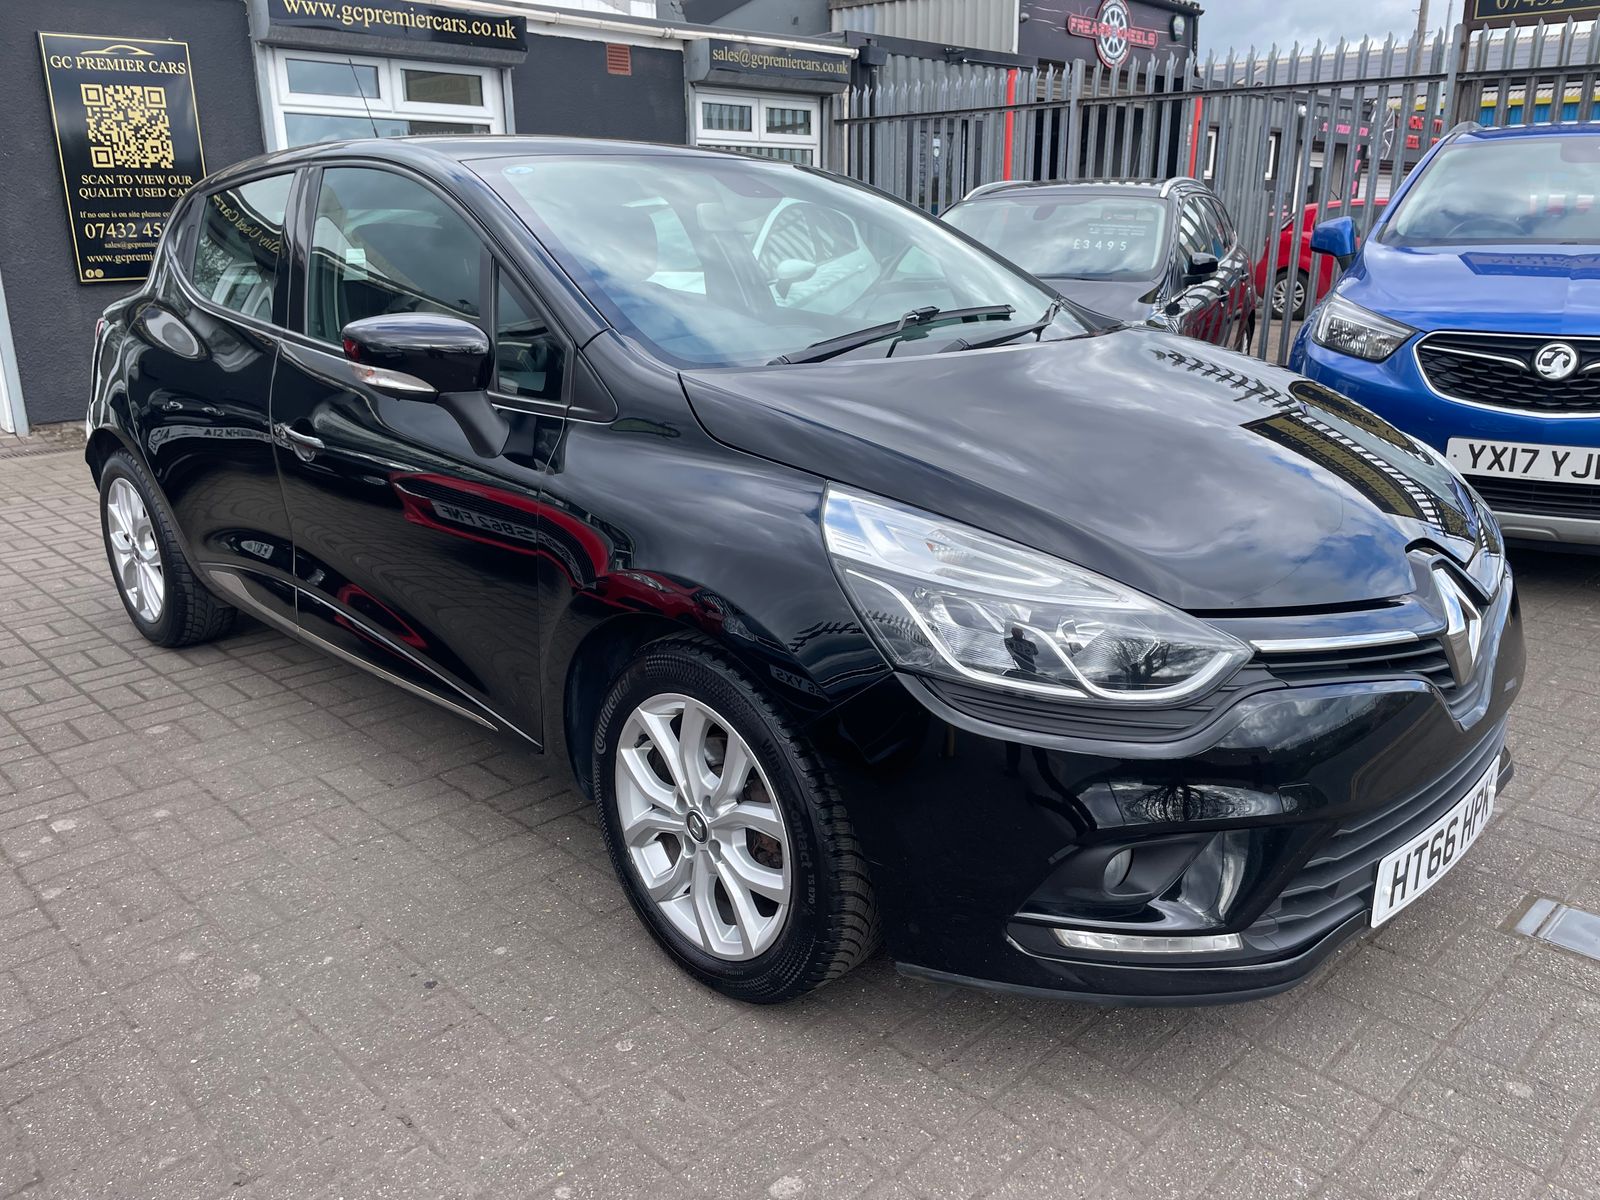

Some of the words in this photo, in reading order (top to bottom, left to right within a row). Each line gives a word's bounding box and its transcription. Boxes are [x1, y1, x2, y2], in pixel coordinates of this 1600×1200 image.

[283, 0, 517, 39] www.gcpremiercars.co.uk
[50, 55, 72, 69] GC
[76, 57, 146, 73] PREMIER
[149, 61, 186, 75] CARS
[712, 47, 848, 75] sales@gcpremiercars.co.uk
[81, 174, 115, 185] SCAN
[116, 175, 133, 185] TO
[135, 175, 166, 185] VIEW
[168, 175, 193, 185] OUR
[79, 187, 133, 199] QUALITY
[135, 188, 166, 198] USED
[80, 211, 87, 219] If
[111, 211, 118, 219] is
[141, 211, 161, 219] please
[85, 222, 138, 239] 07432
[142, 222, 165, 238] 45
[1468, 443, 1540, 474] YX17
[594, 672, 631, 755] Continental
[1388, 816, 1459, 909] HT66
